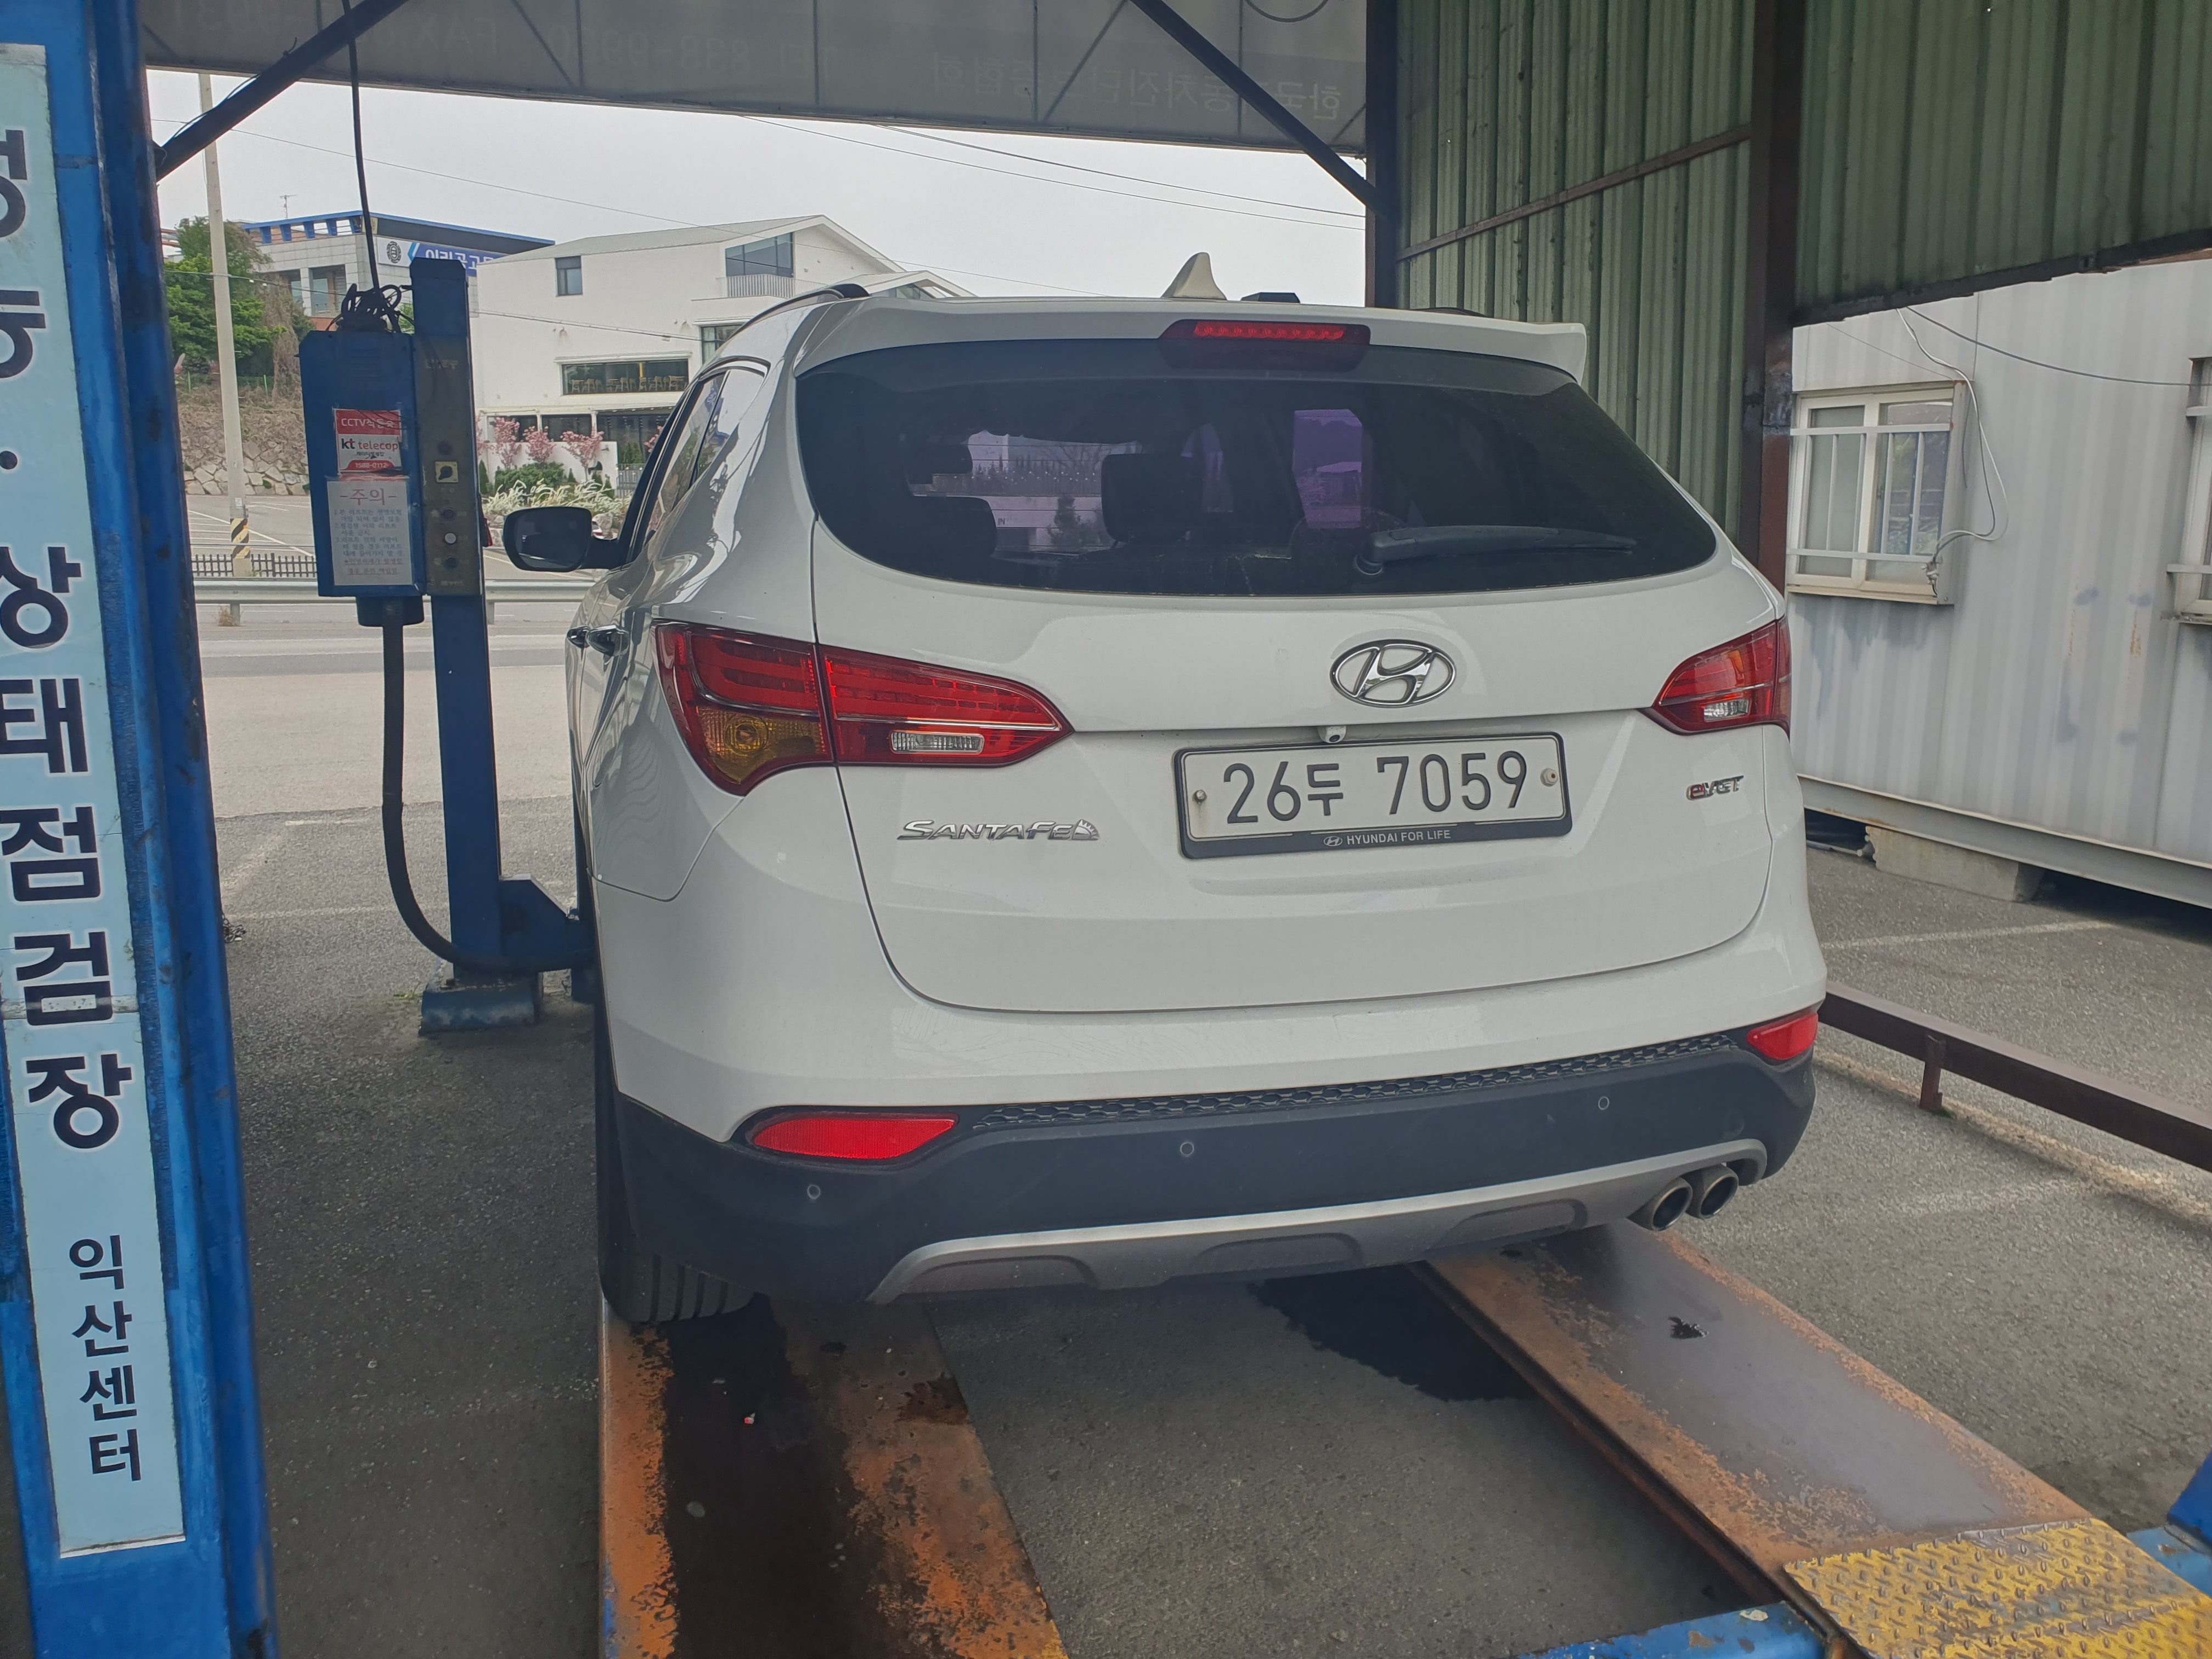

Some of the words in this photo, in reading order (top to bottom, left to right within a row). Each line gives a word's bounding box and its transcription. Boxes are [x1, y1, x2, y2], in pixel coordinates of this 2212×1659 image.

[425, 249, 494, 270] 이리공고
[341, 438, 356, 449] kt
[358, 440, 398, 452] telecop
[1223, 761, 1344, 825] 26두
[1376, 750, 1527, 816] 7059
[1346, 832, 1398, 845] HYUNDAI
[1400, 831, 1425, 843] FOR
[1427, 829, 1452, 841] LIFE
[69, 1234, 142, 1482] 익산센터
